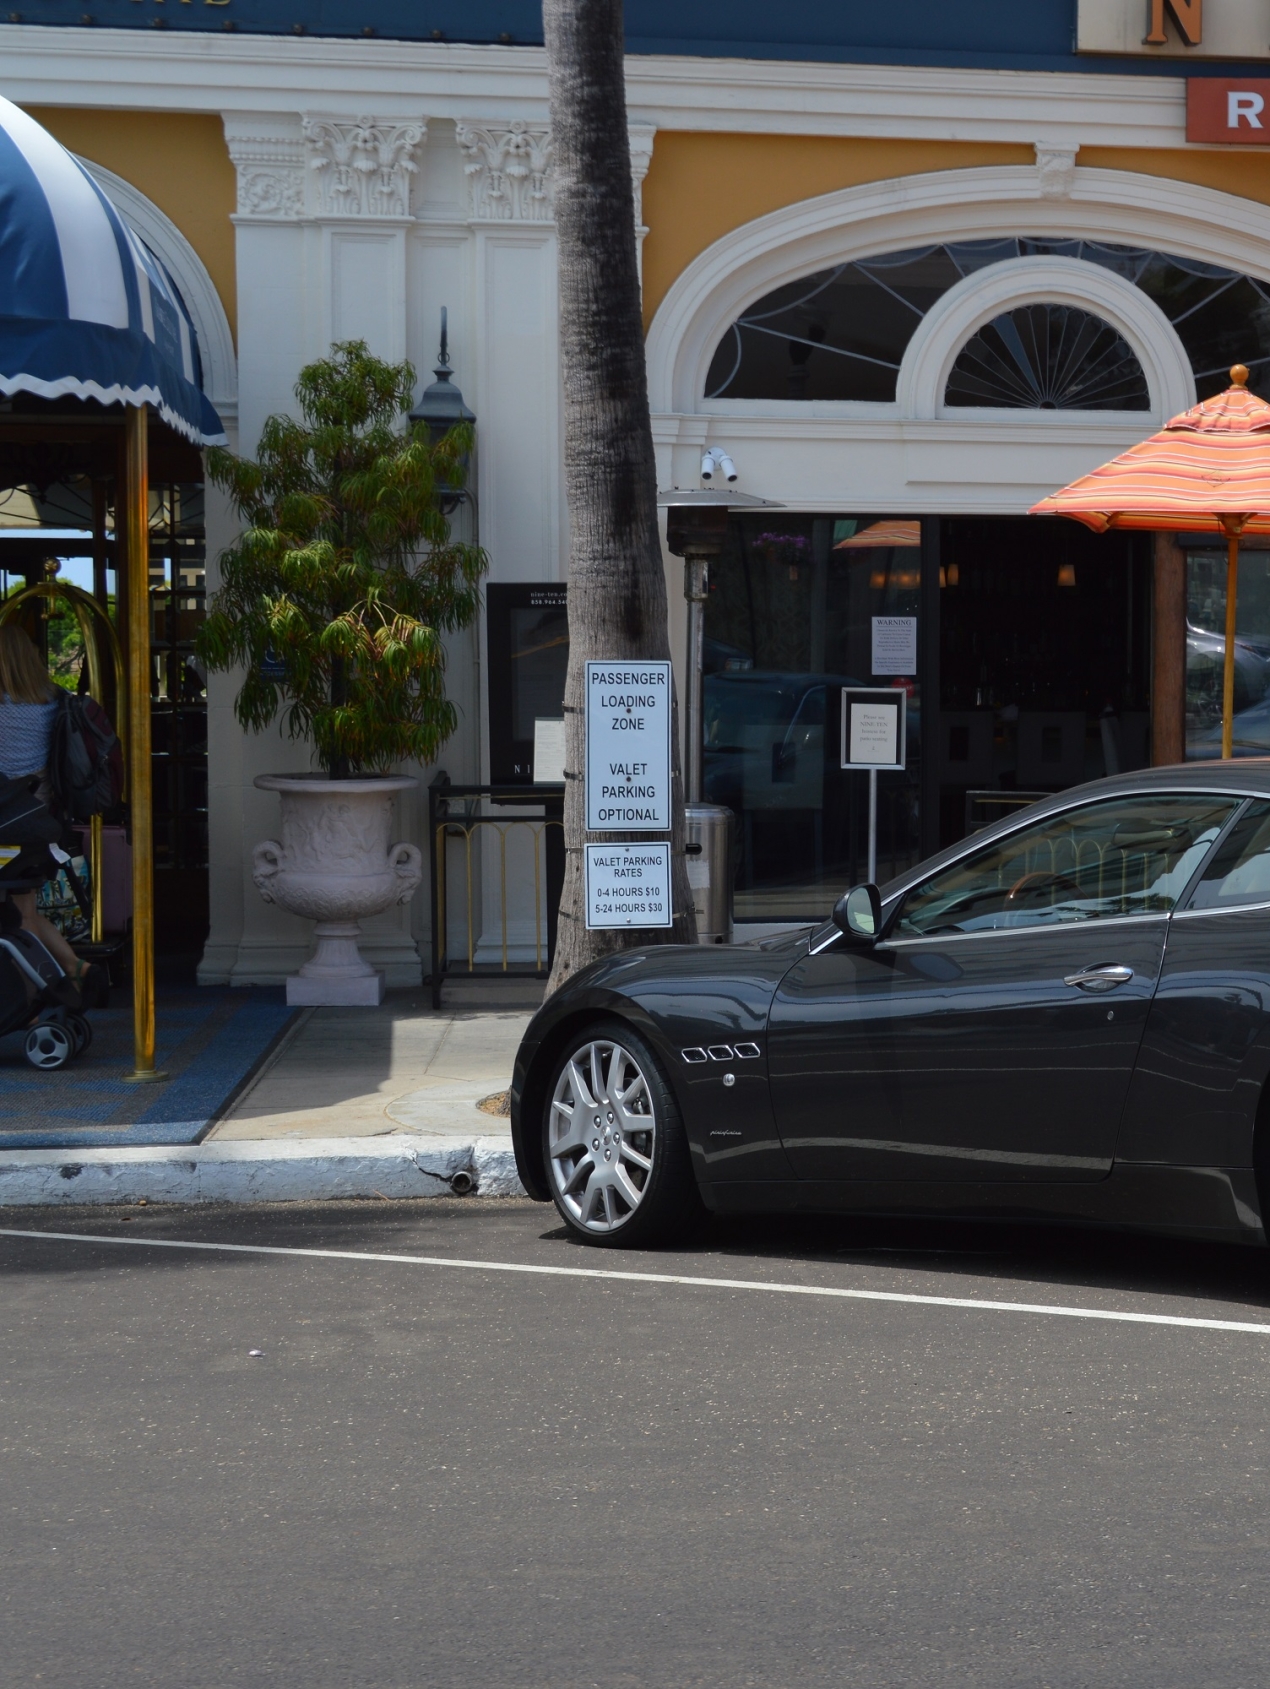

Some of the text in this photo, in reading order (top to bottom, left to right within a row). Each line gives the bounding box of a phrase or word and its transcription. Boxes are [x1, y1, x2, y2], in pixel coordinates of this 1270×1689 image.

[592, 672, 665, 684] PASSENGER
[602, 696, 656, 708] LOADING
[612, 718, 644, 730] ZONE
[610, 763, 647, 775] VALET
[602, 786, 655, 798] PARKING
[598, 809, 659, 820] OPTIONAL
[594, 856, 662, 866] VALET PARKING
[614, 868, 642, 877] RATES
[597, 887, 660, 897] 0-4 HOURS $10
[596, 903, 662, 913] 5-24 HOURS $30
